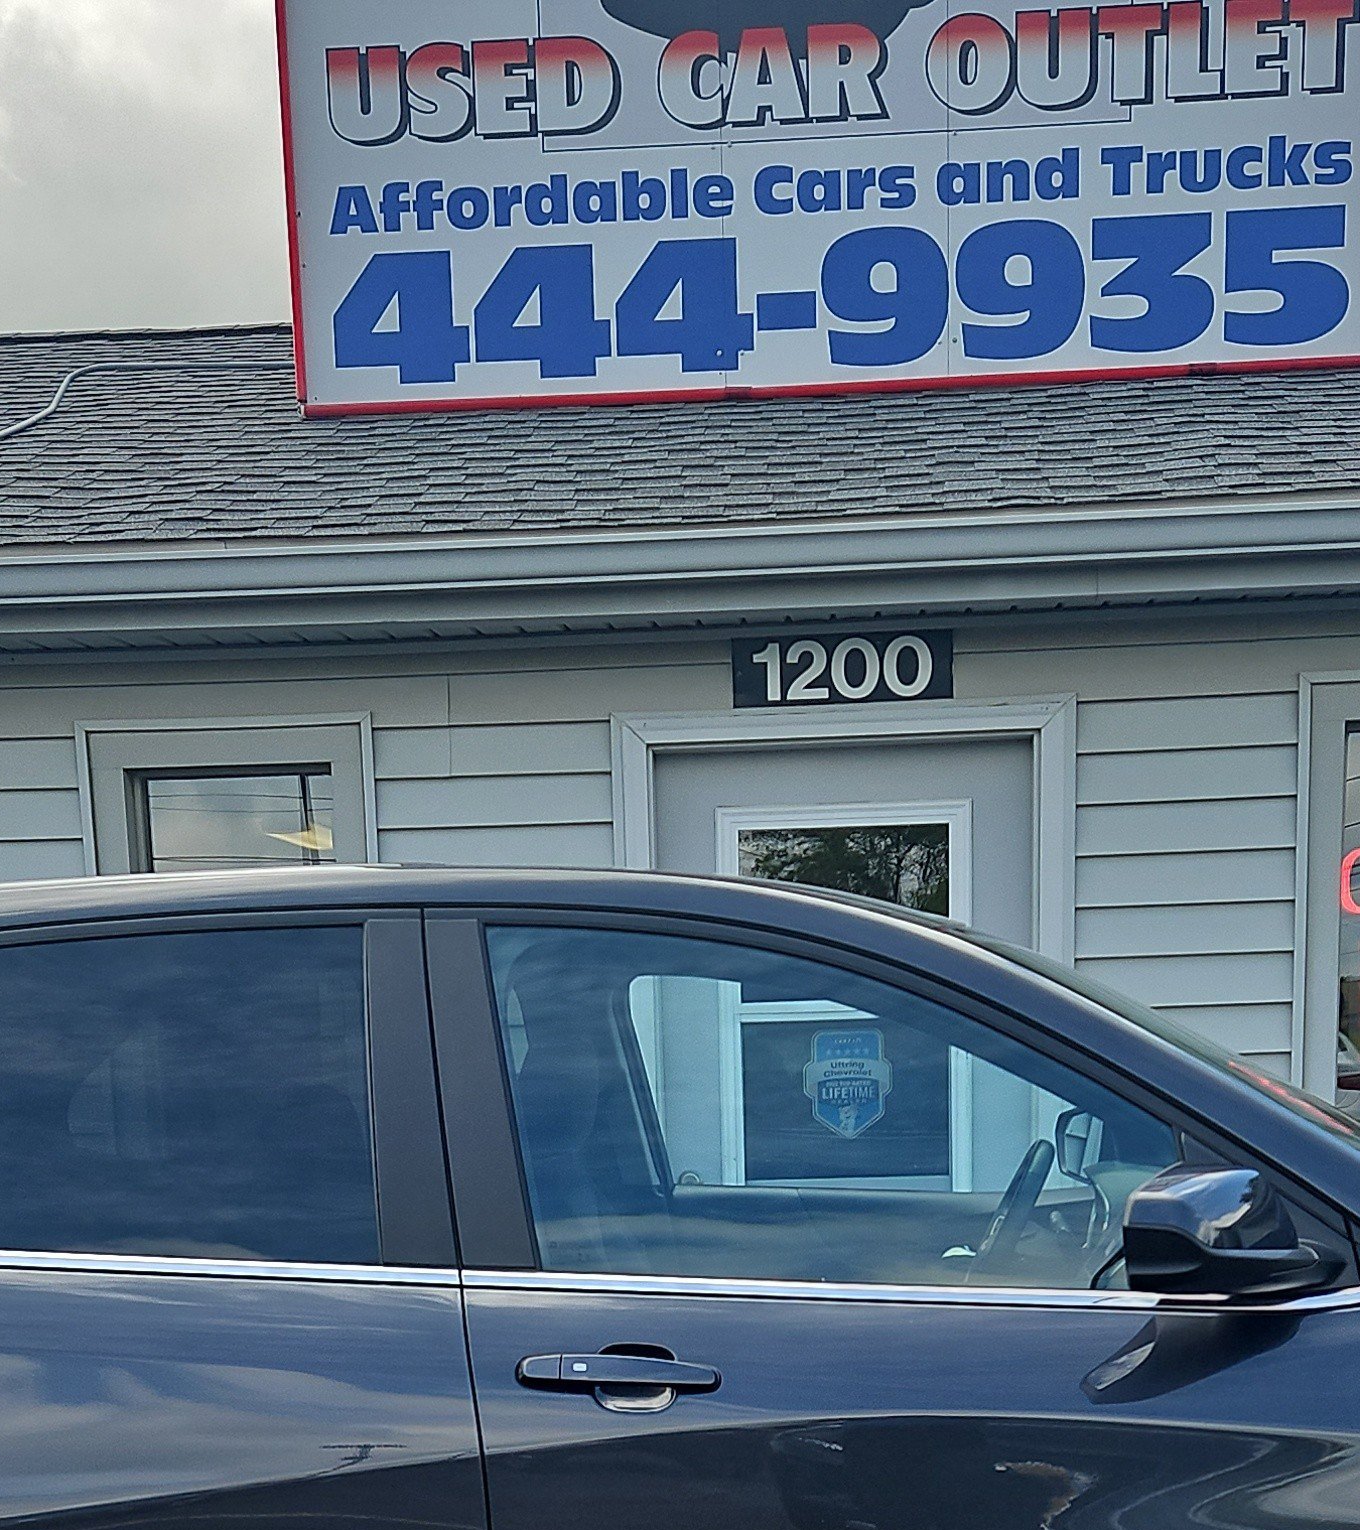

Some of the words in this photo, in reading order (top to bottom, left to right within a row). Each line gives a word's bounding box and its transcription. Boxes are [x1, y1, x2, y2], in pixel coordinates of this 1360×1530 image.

[325, 36, 622, 147] USED
[657, 23, 889, 130] CAR
[925, 0, 1360, 116] OUTLET
[329, 167, 735, 236] Affordable
[752, 164, 917, 216] Cars
[935, 146, 1081, 207] and
[1099, 134, 1353, 197] Trucks
[332, 203, 1351, 385] 444-9935
[751, 634, 934, 701] 1200
[821, 1086, 876, 1100] LIFETIME
